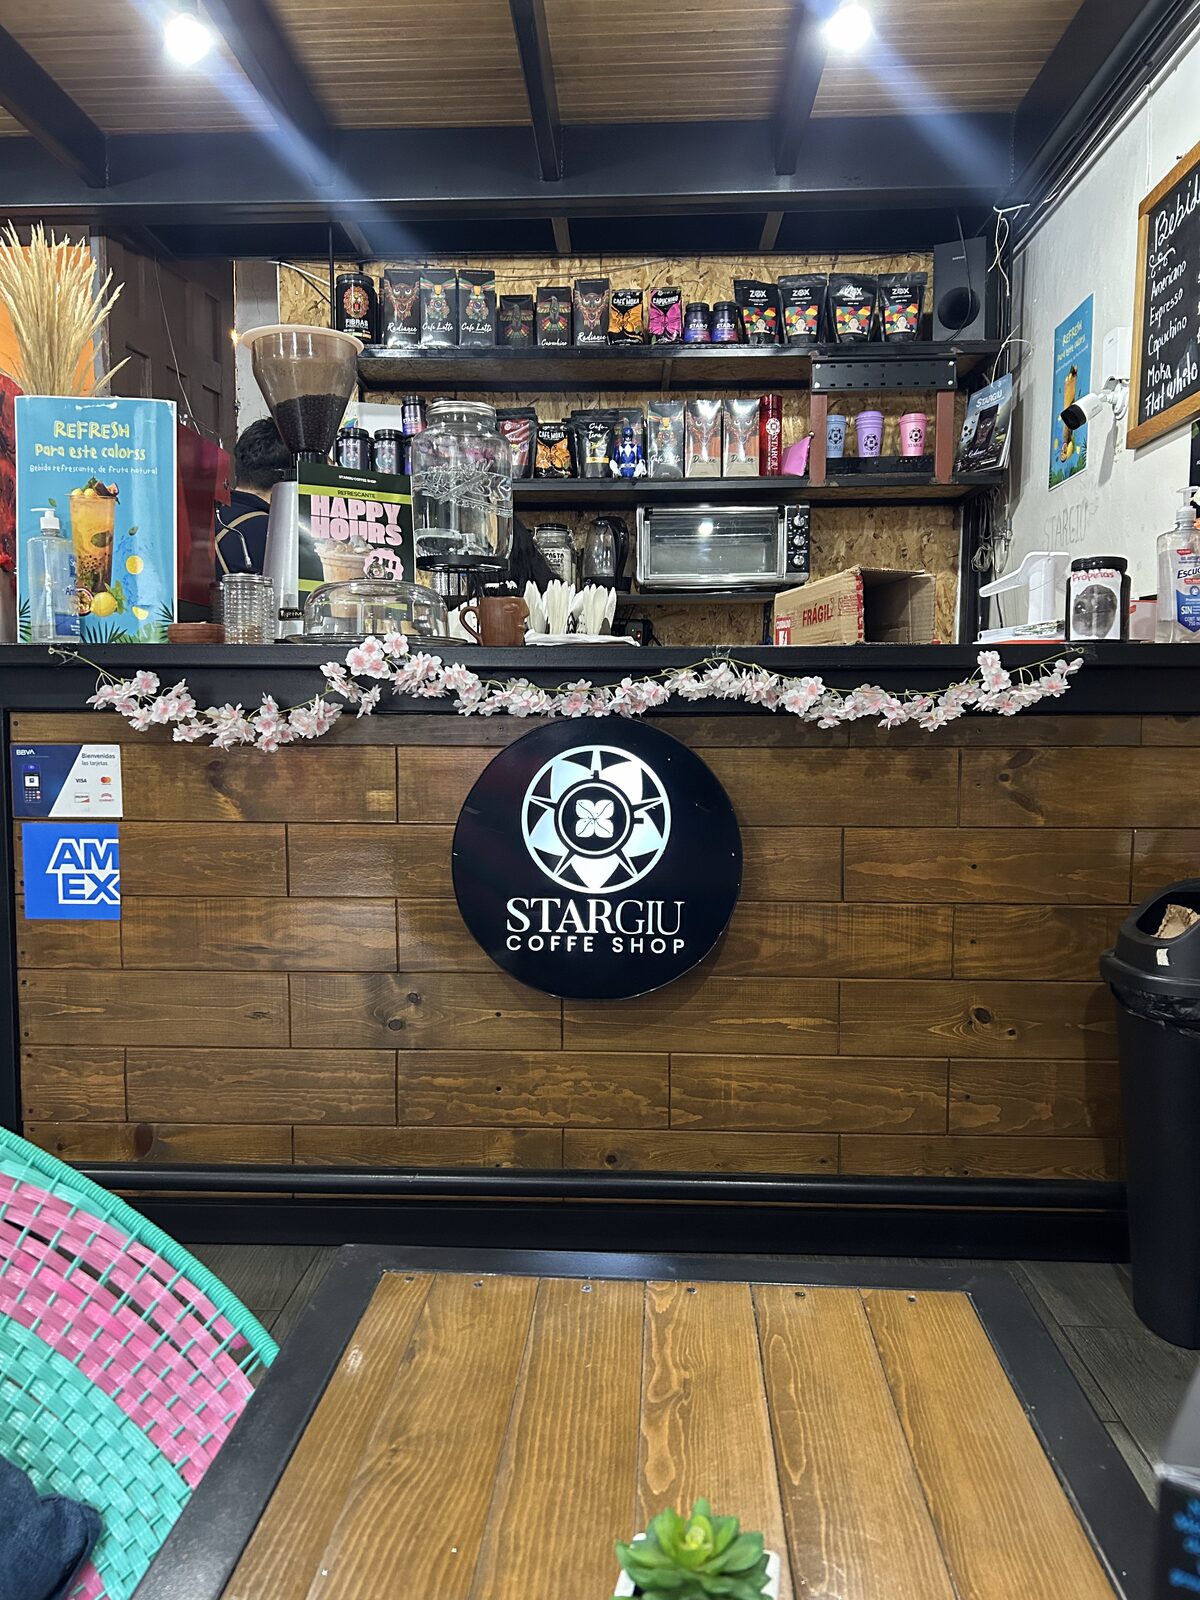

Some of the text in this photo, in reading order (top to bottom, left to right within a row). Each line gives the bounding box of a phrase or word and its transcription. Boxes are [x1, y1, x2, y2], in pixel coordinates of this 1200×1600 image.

[1154, 172, 1200, 253] Bebid
[1151, 259, 1187, 302] Americano
[345, 319, 369, 327] FIBRAS
[1149, 287, 1184, 328] Expresso
[1147, 315, 1188, 360] Capuchino
[1146, 362, 1172, 388] Moka
[1144, 382, 1166, 417] Flat
[53, 420, 130, 440] REFRESH
[68, 444, 98, 459] este
[29, 464, 52, 473] Bebida
[97, 466, 106, 474] de
[130, 467, 158, 475] natural
[310, 494, 401, 525] HAPPY
[337, 489, 376, 499] REFRESCANTE
[310, 515, 403, 546] HOURS
[1072, 571, 1115, 581] Propinas
[802, 602, 832, 627] FRÁGIL
[46, 838, 120, 874] AM
[58, 872, 121, 905] EX
[506, 897, 686, 936] STARGIU
[506, 934, 685, 954] COFFE SHOP
